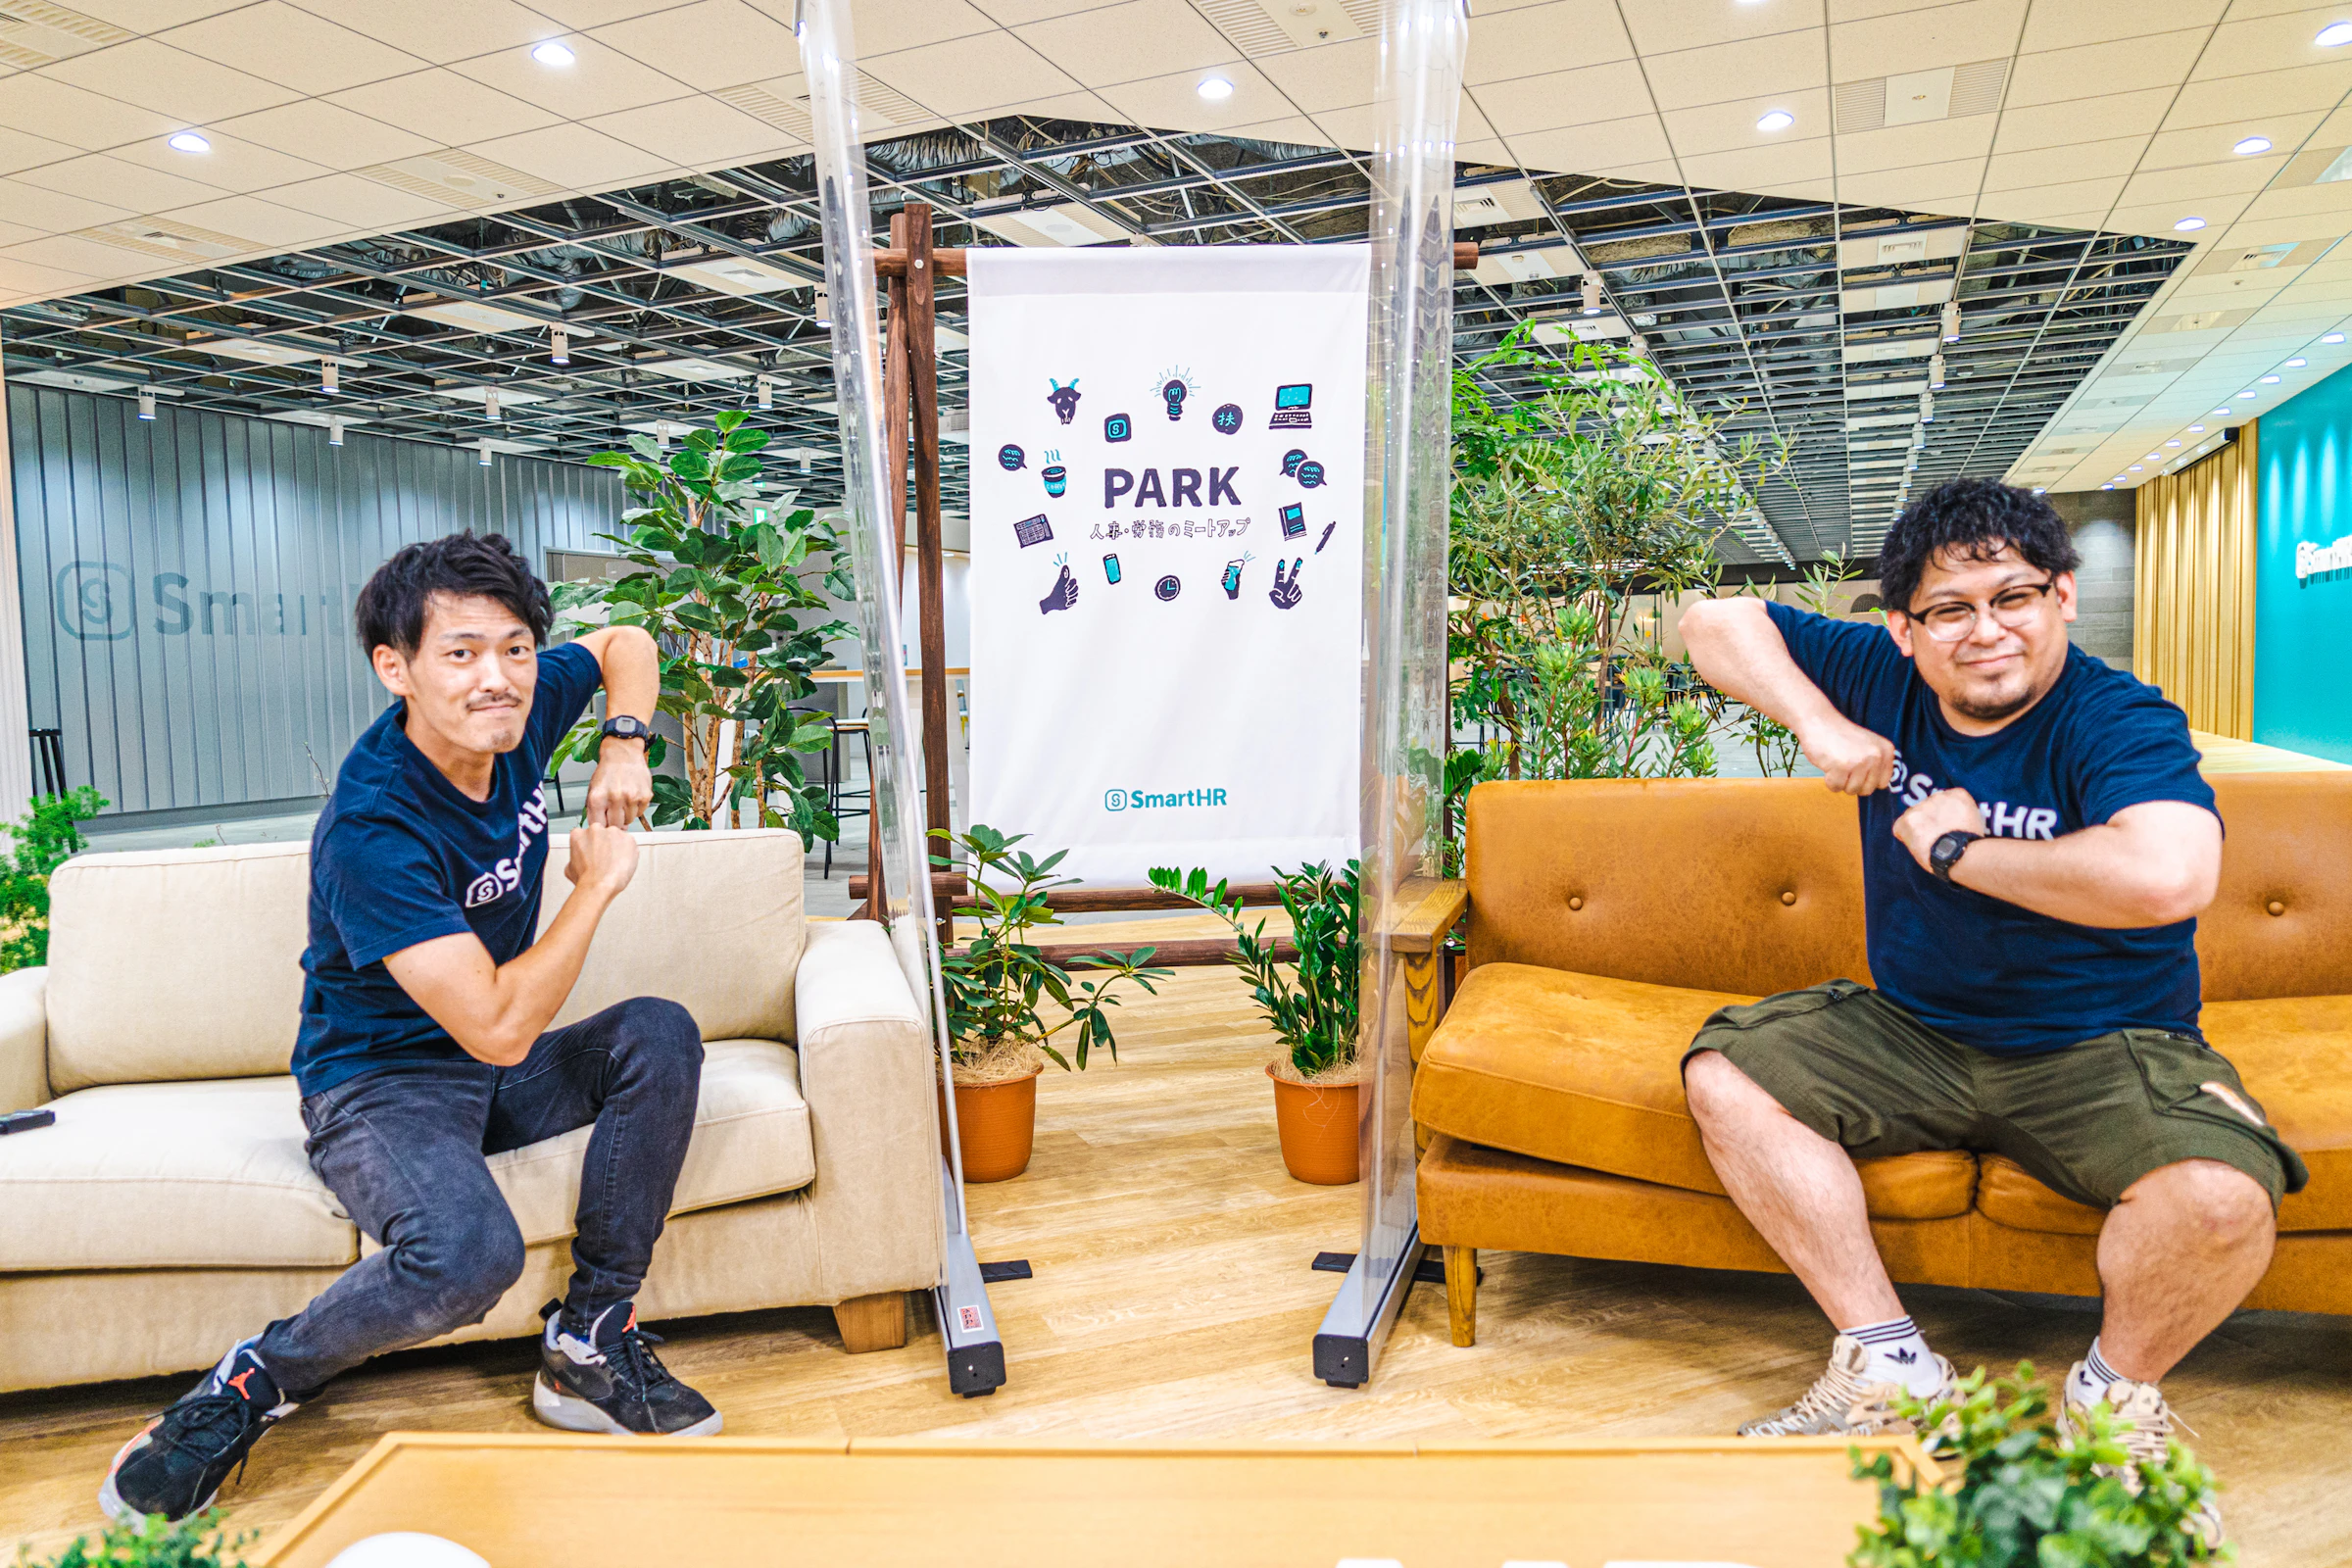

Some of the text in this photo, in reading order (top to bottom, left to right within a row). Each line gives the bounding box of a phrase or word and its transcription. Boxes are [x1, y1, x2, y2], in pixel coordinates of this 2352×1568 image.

[1217, 412, 1236, 427] 扶
[1103, 466, 1243, 510] PARK
[1090, 516, 1251, 540] 人事・労務のミートアップ
[1130, 788, 1228, 809] SmartHR
